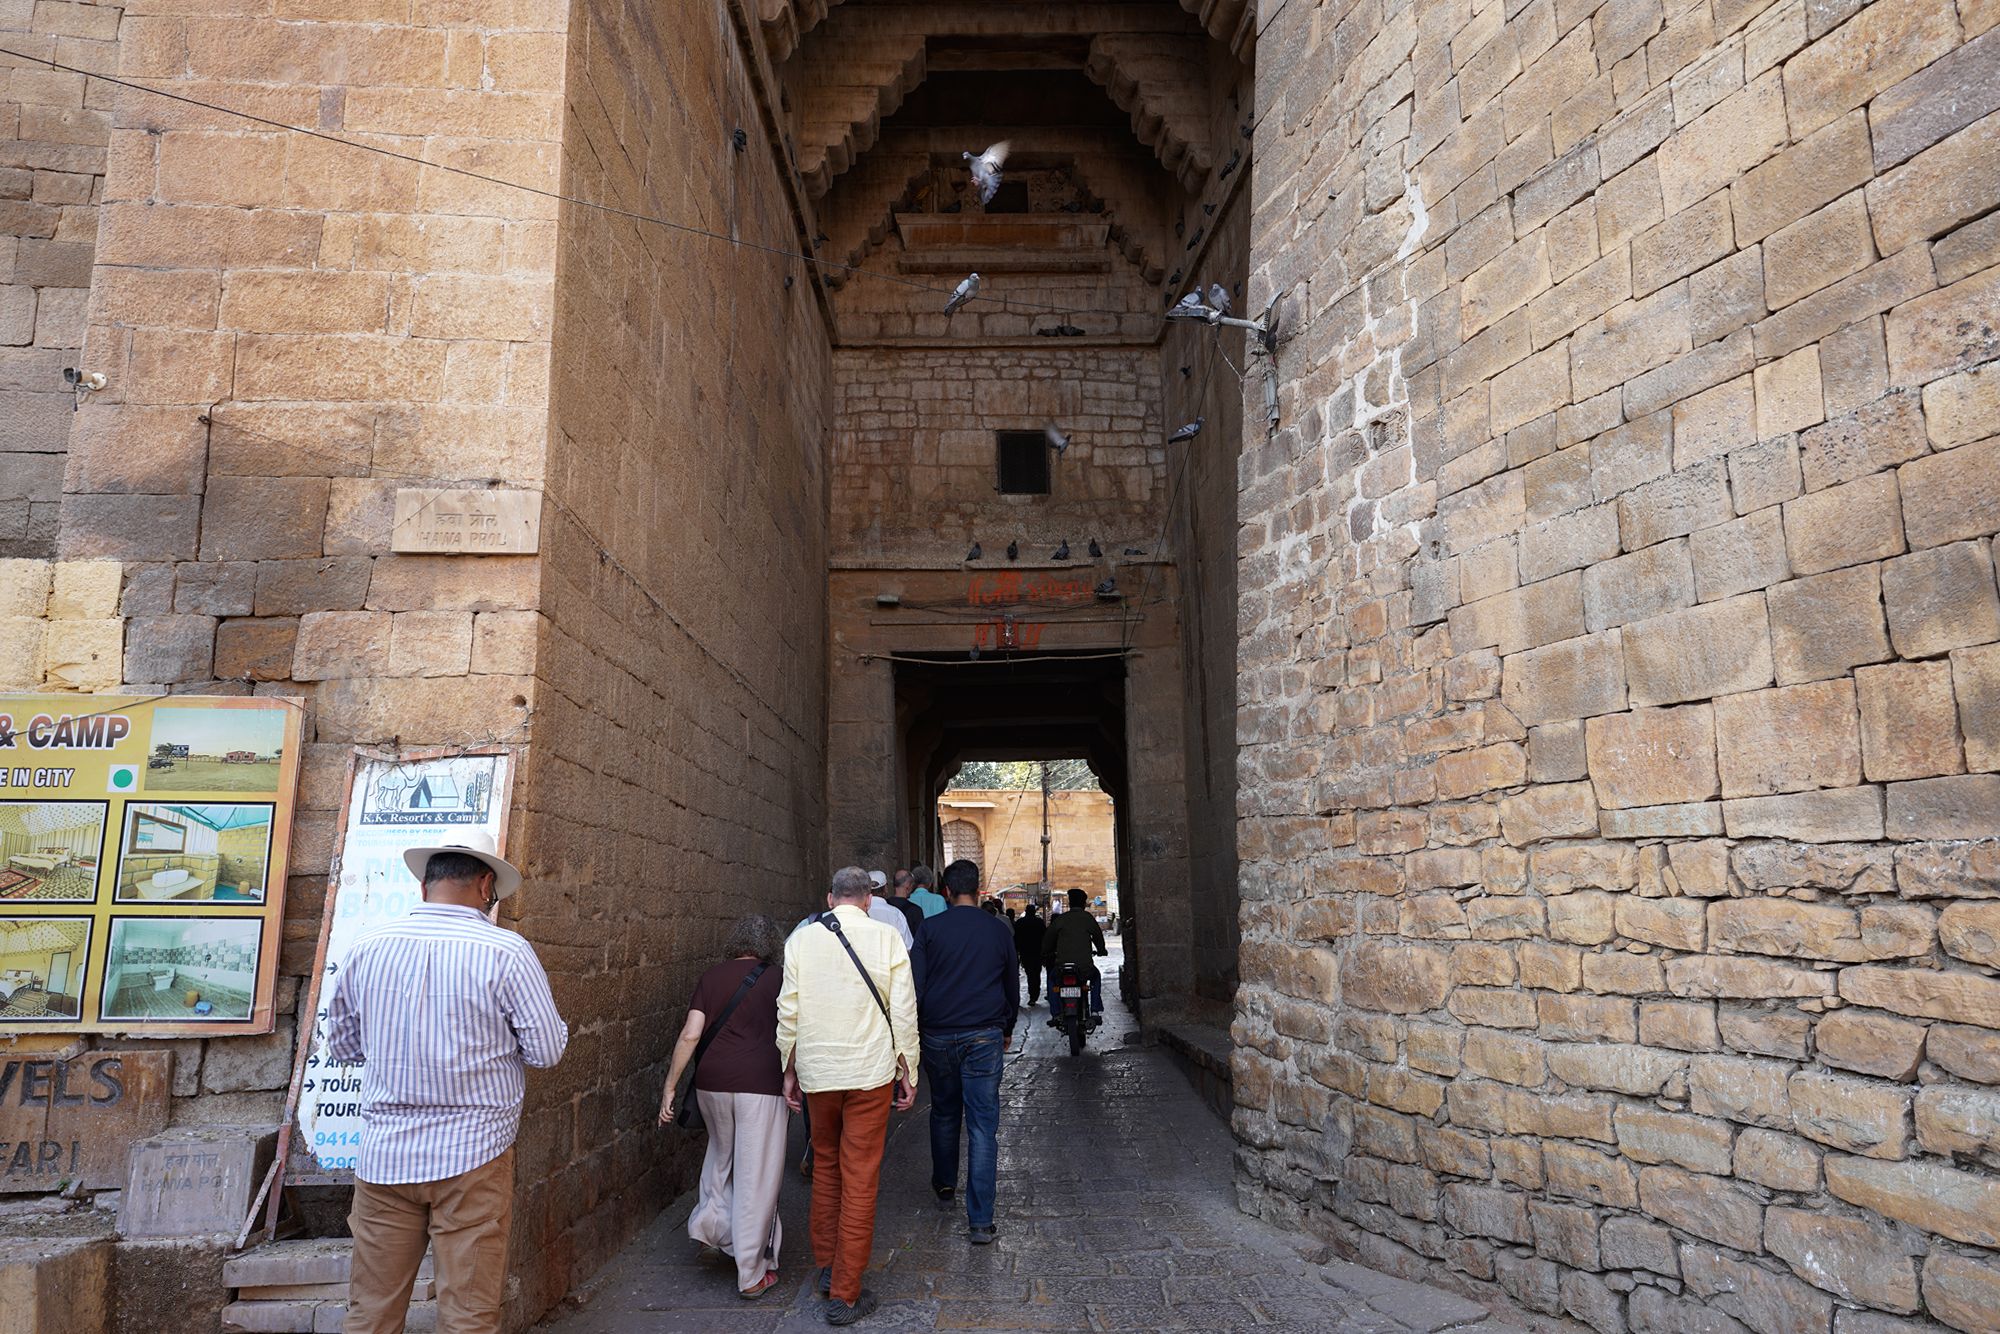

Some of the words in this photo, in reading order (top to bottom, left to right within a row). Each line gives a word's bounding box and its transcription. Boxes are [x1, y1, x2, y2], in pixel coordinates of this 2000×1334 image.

[27, 713, 130, 749] CAMP
[11, 767, 31, 788] IN
[33, 767, 75, 788] CITY
[362, 813, 387, 823] K.K.
[389, 812, 432, 823] Resort's
[434, 812, 444, 822] &
[447, 812, 487, 824] Camp's
[321, 1078, 362, 1092] TOUR
[315, 1131, 360, 1146] 9414
[141, 1177, 193, 1191] HAWA
